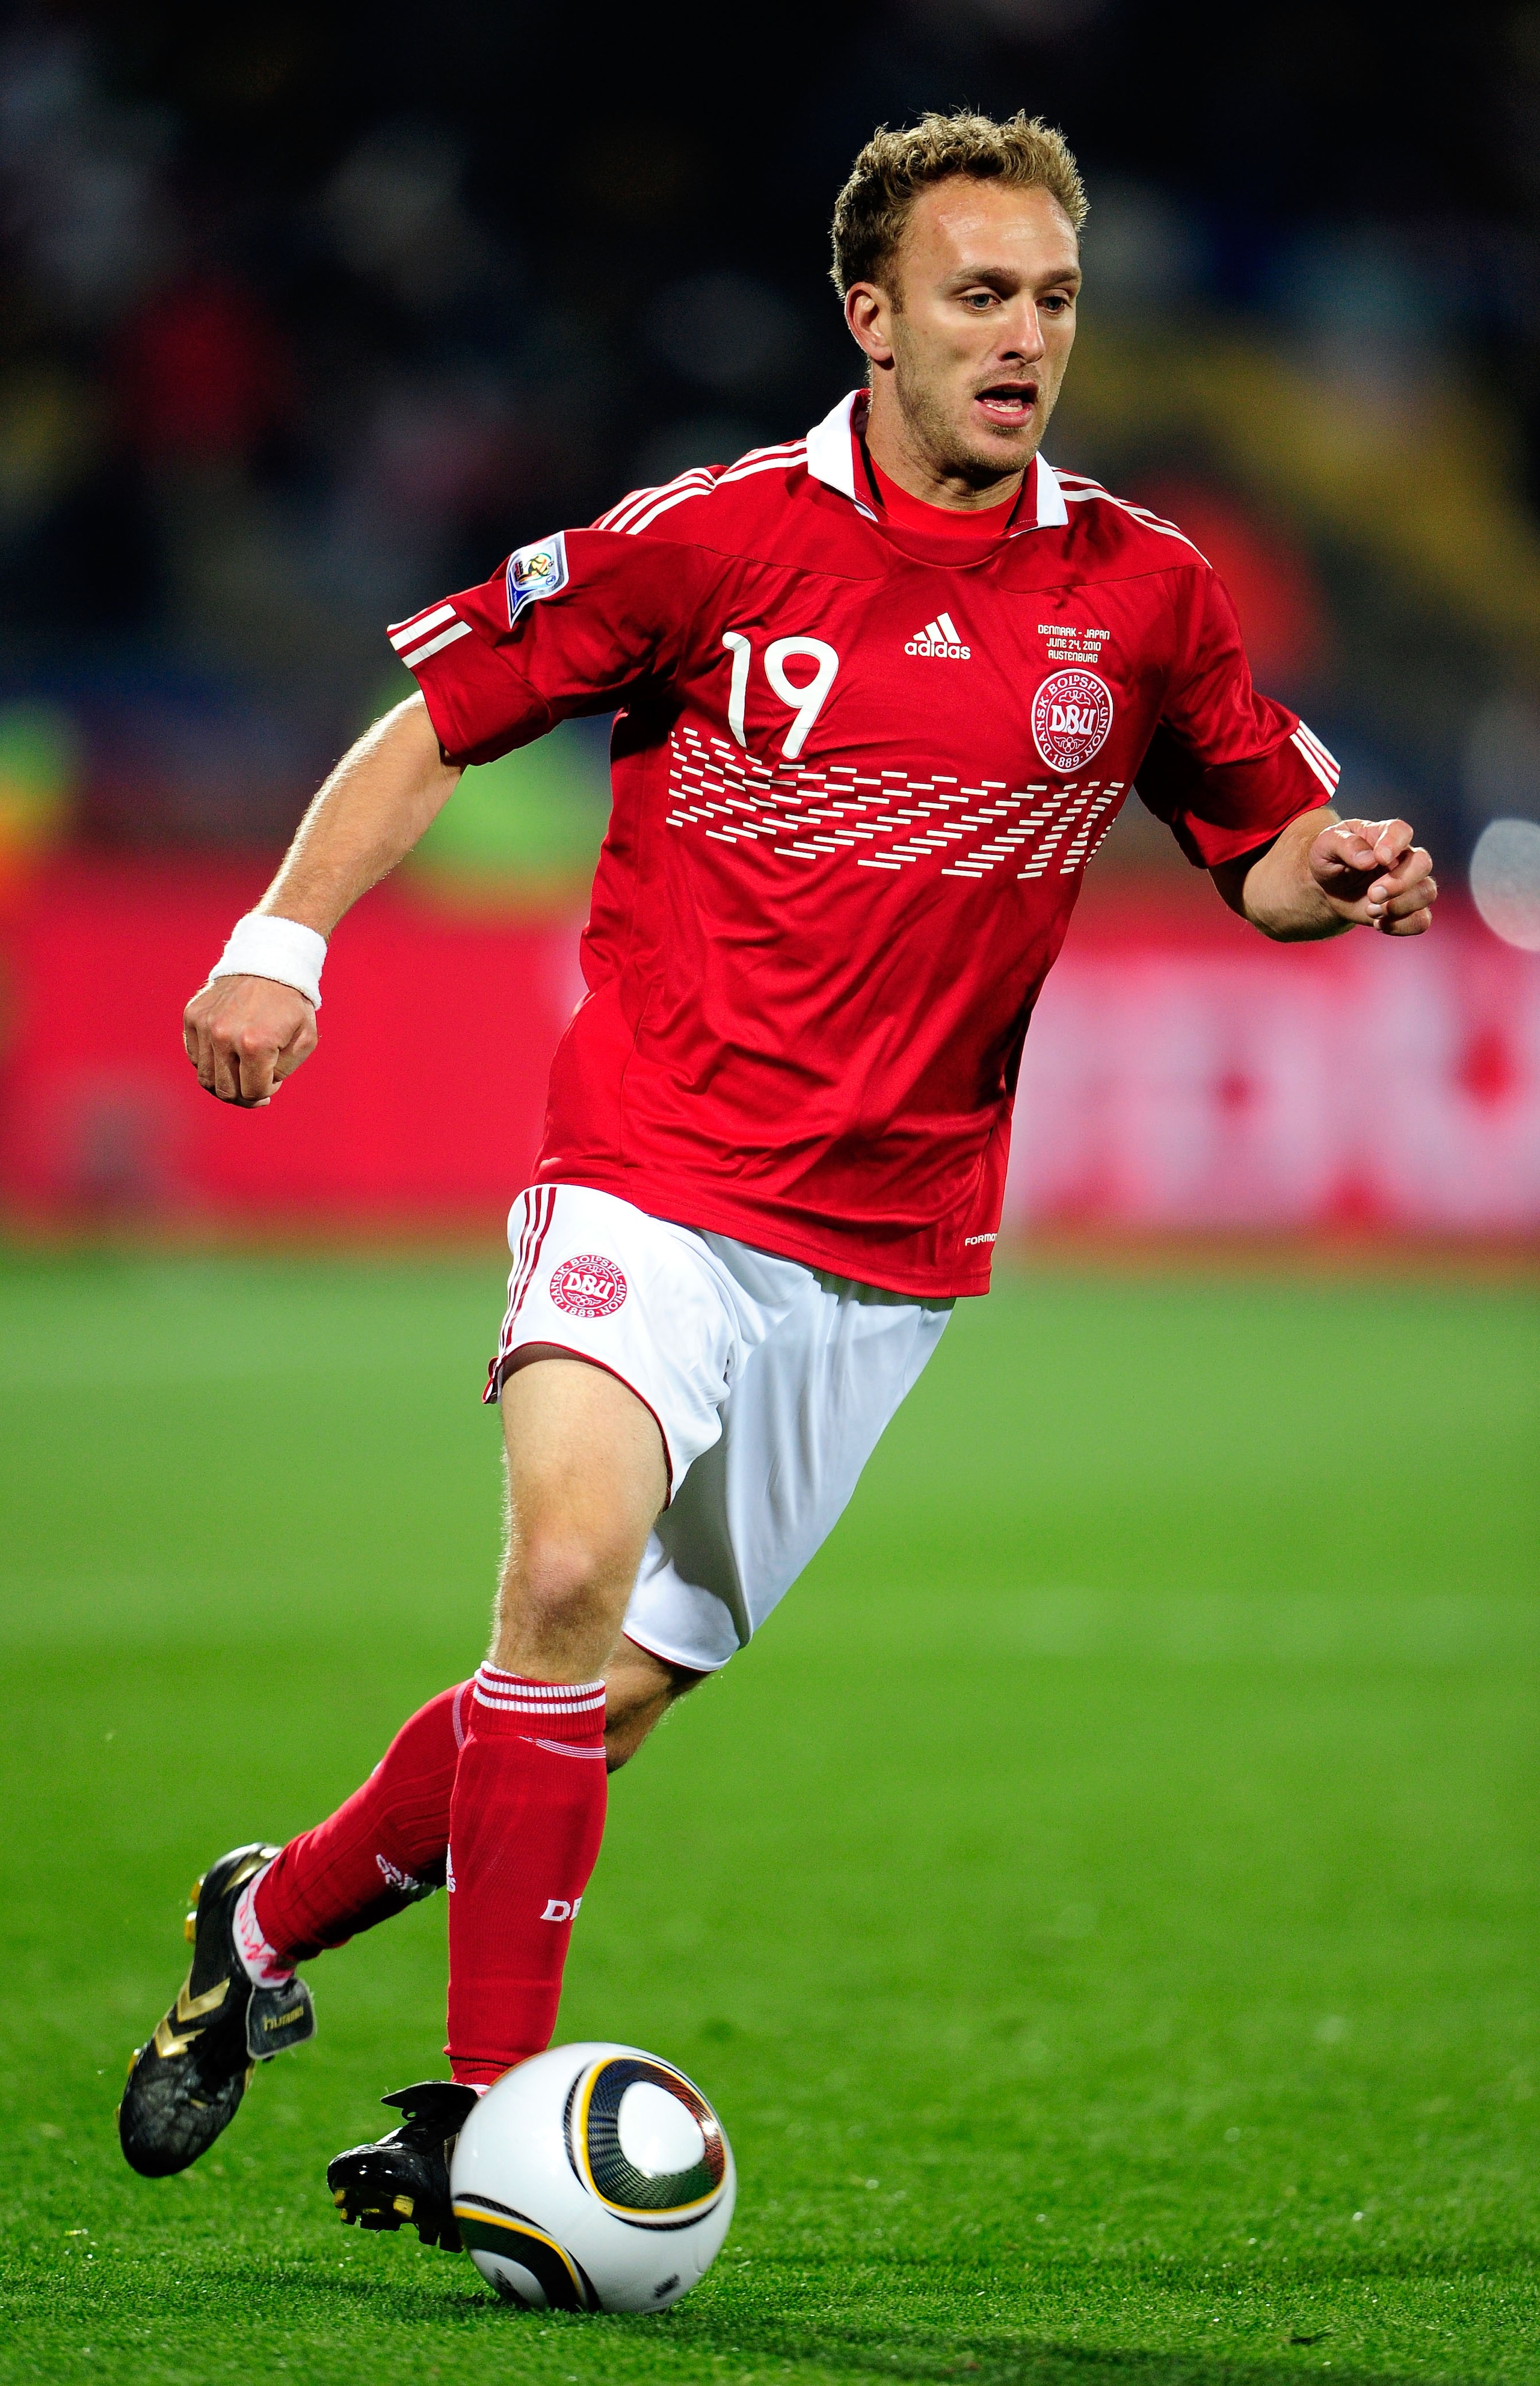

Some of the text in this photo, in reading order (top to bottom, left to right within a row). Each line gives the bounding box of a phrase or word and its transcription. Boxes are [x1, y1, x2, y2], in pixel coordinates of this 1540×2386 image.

[1038, 624, 1077, 637] DENMARK
[1084, 629, 1110, 640] JAPAN
[904, 640, 971, 660] adidas
[1046, 638, 1101, 651] JUNE 24, 2010
[1048, 650, 1098, 663] RUSTENBURG
[722, 632, 839, 759] 19
[1036, 697, 1052, 753] DANSK
[1049, 704, 1097, 735] DBU
[1052, 754, 1080, 768] 1889
[550, 1266, 569, 1305] DANSK
[563, 1271, 615, 1300] DBU
[562, 1304, 595, 1318] 1889
